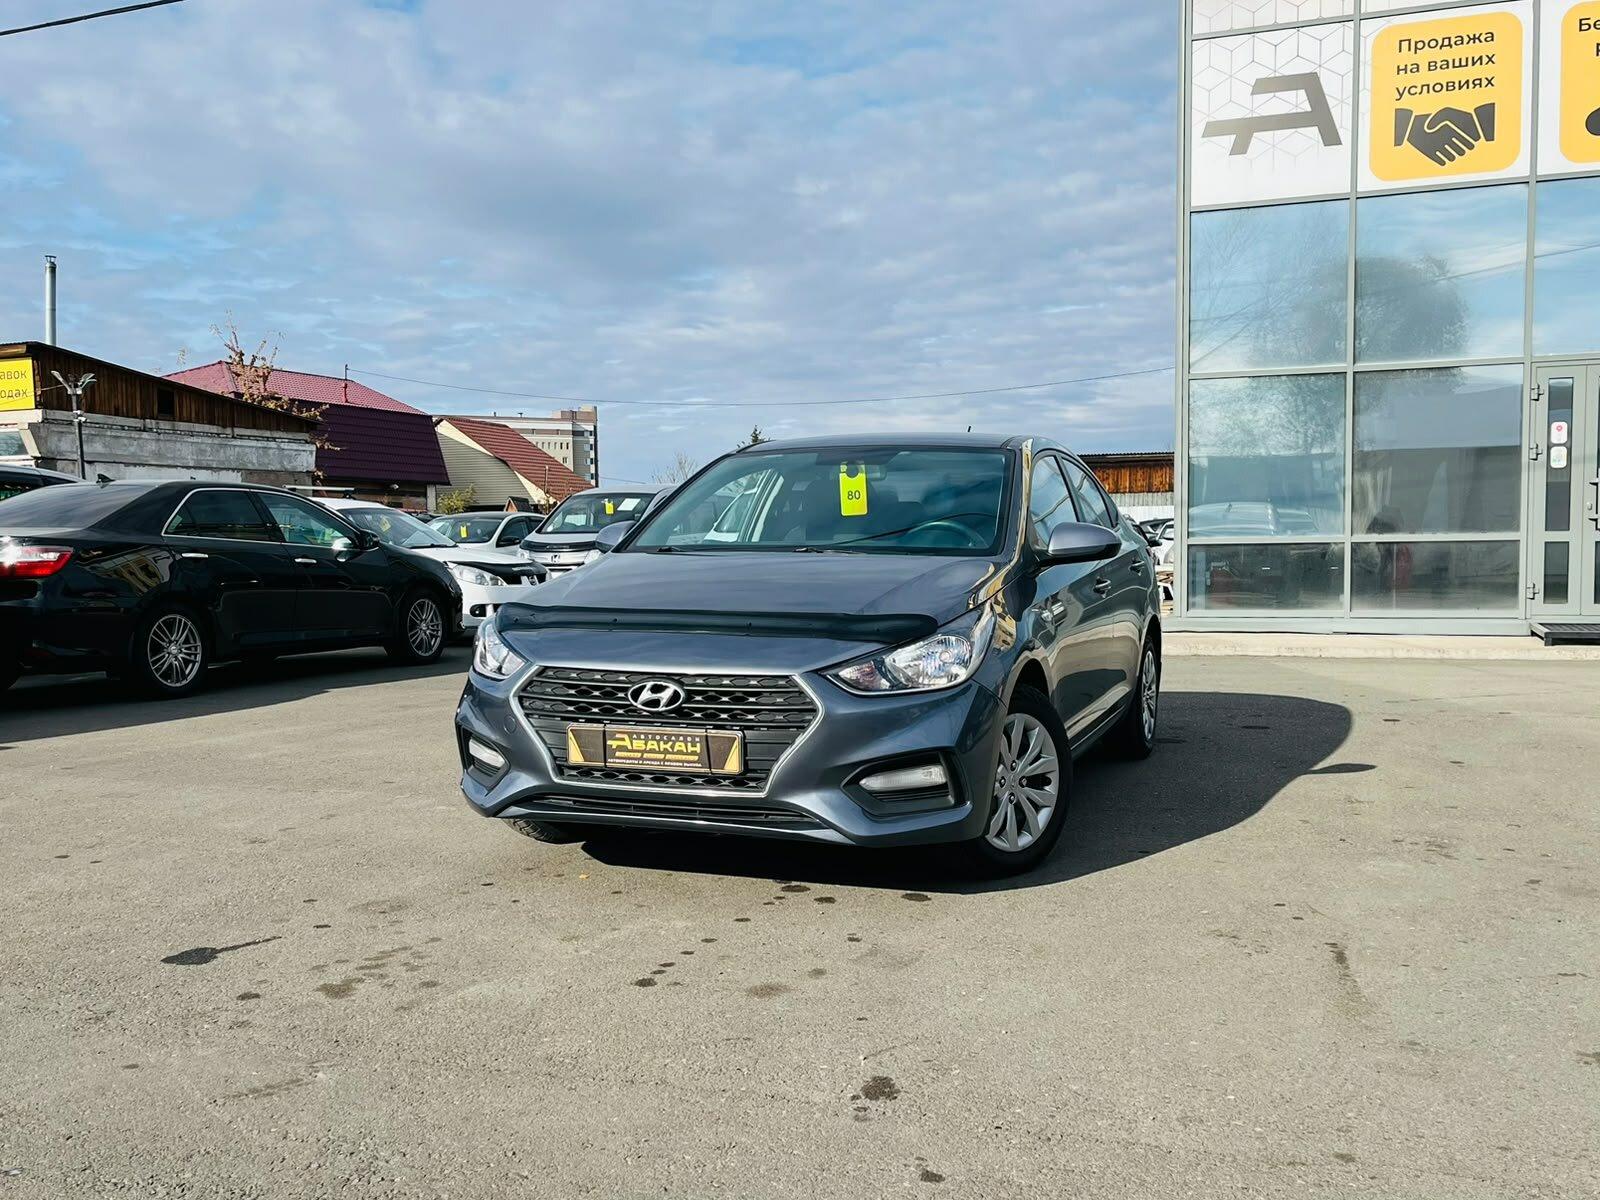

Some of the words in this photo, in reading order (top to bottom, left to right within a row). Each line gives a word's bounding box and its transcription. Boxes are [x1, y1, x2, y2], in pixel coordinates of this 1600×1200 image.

[1398, 31, 1495, 54] Продажа
[1396, 62, 1420, 75] на
[1428, 54, 1496, 71] ваших
[1395, 76, 1495, 101] условиях
[847, 490, 861, 500] 80
